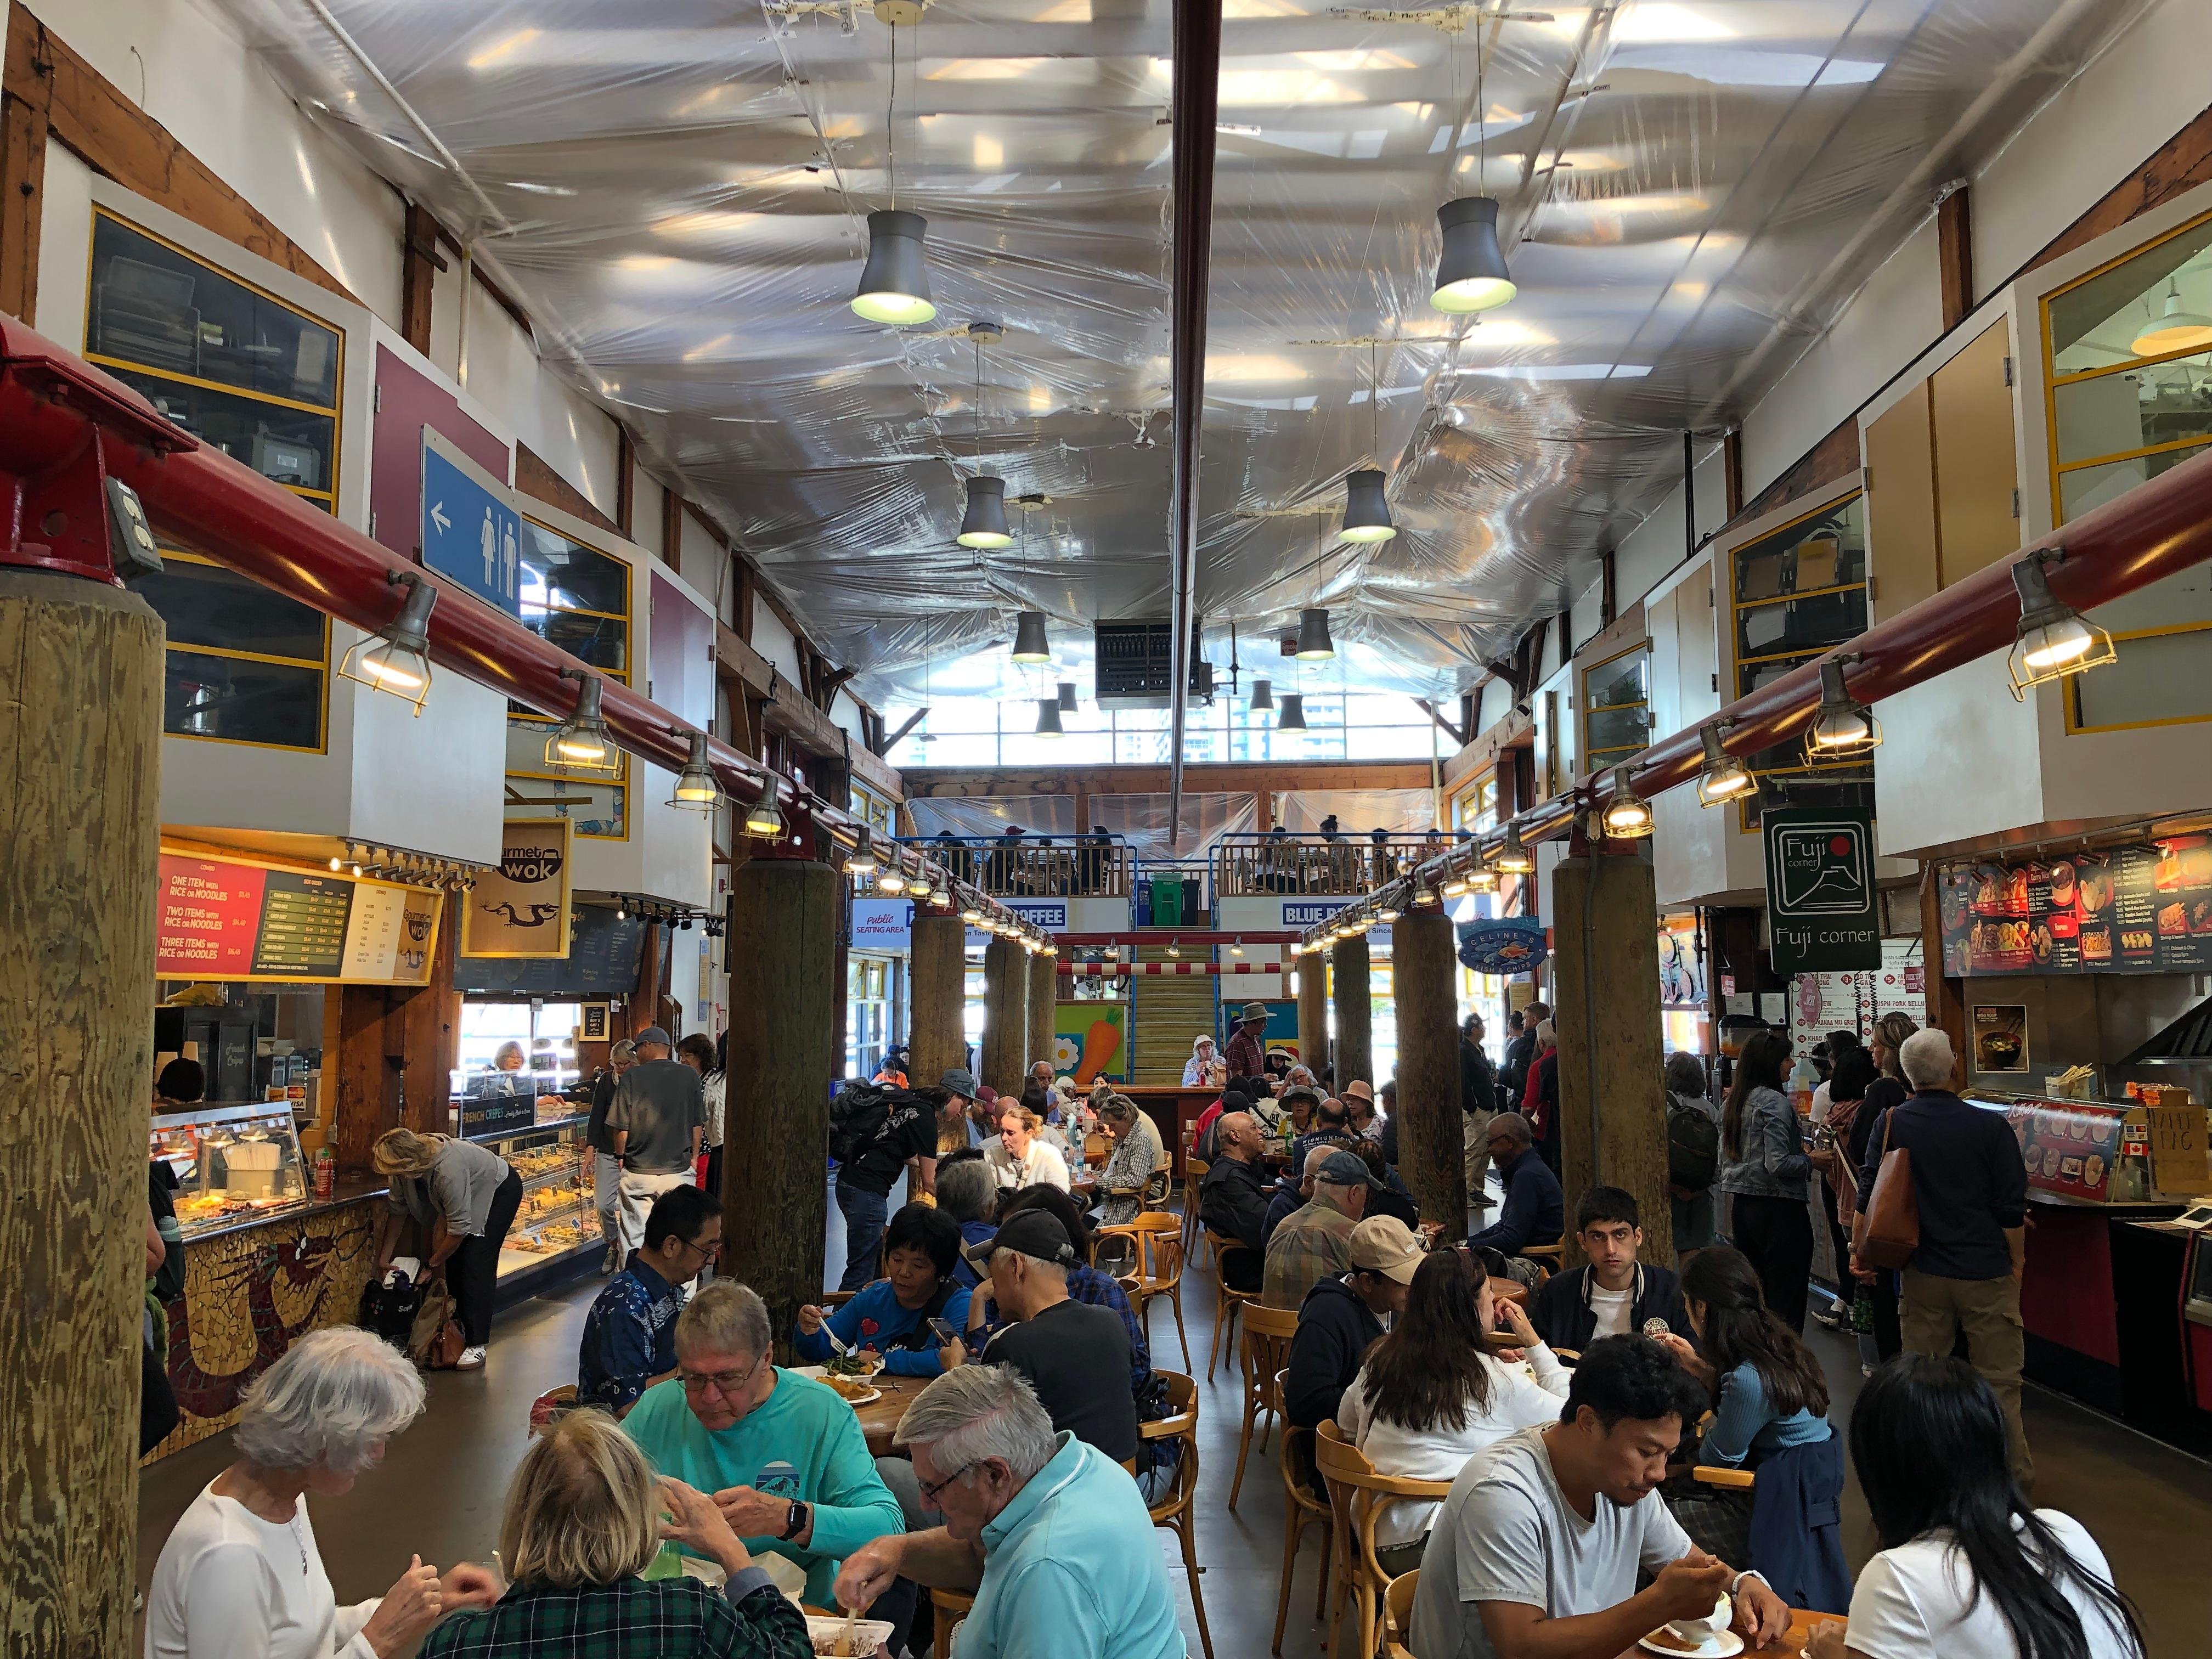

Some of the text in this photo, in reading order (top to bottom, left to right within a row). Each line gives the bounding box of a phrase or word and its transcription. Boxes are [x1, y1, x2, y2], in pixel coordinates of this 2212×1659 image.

[501, 847, 542, 859] urmet
[1787, 836, 1825, 871] Fuji
[505, 860, 553, 879] wok
[1788, 859, 1819, 867] corner
[171, 875, 187, 886] ONE
[188, 877, 205, 888] ITEM
[170, 886, 187, 897] RICE
[195, 889, 228, 901] NOODLES
[167, 906, 184, 916] TWO
[184, 907, 206, 918] ITEMS
[1285, 907, 1323, 922] BLUE
[164, 917, 182, 927] RICE
[190, 919, 223, 930] NOODLES
[866, 913, 894, 925] Public
[161, 936, 185, 947] THREE
[185, 938, 206, 948] ITEMS
[1470, 933, 1534, 946] CELINE'S
[1776, 927, 1874, 958] Fuji corner
[159, 947, 176, 957] RICE
[185, 949, 218, 960] NOODLES
[1475, 964, 1494, 973] FISH
[1506, 962, 1531, 972] CHIPS
[463, 1110, 484, 1124] FRENCH
